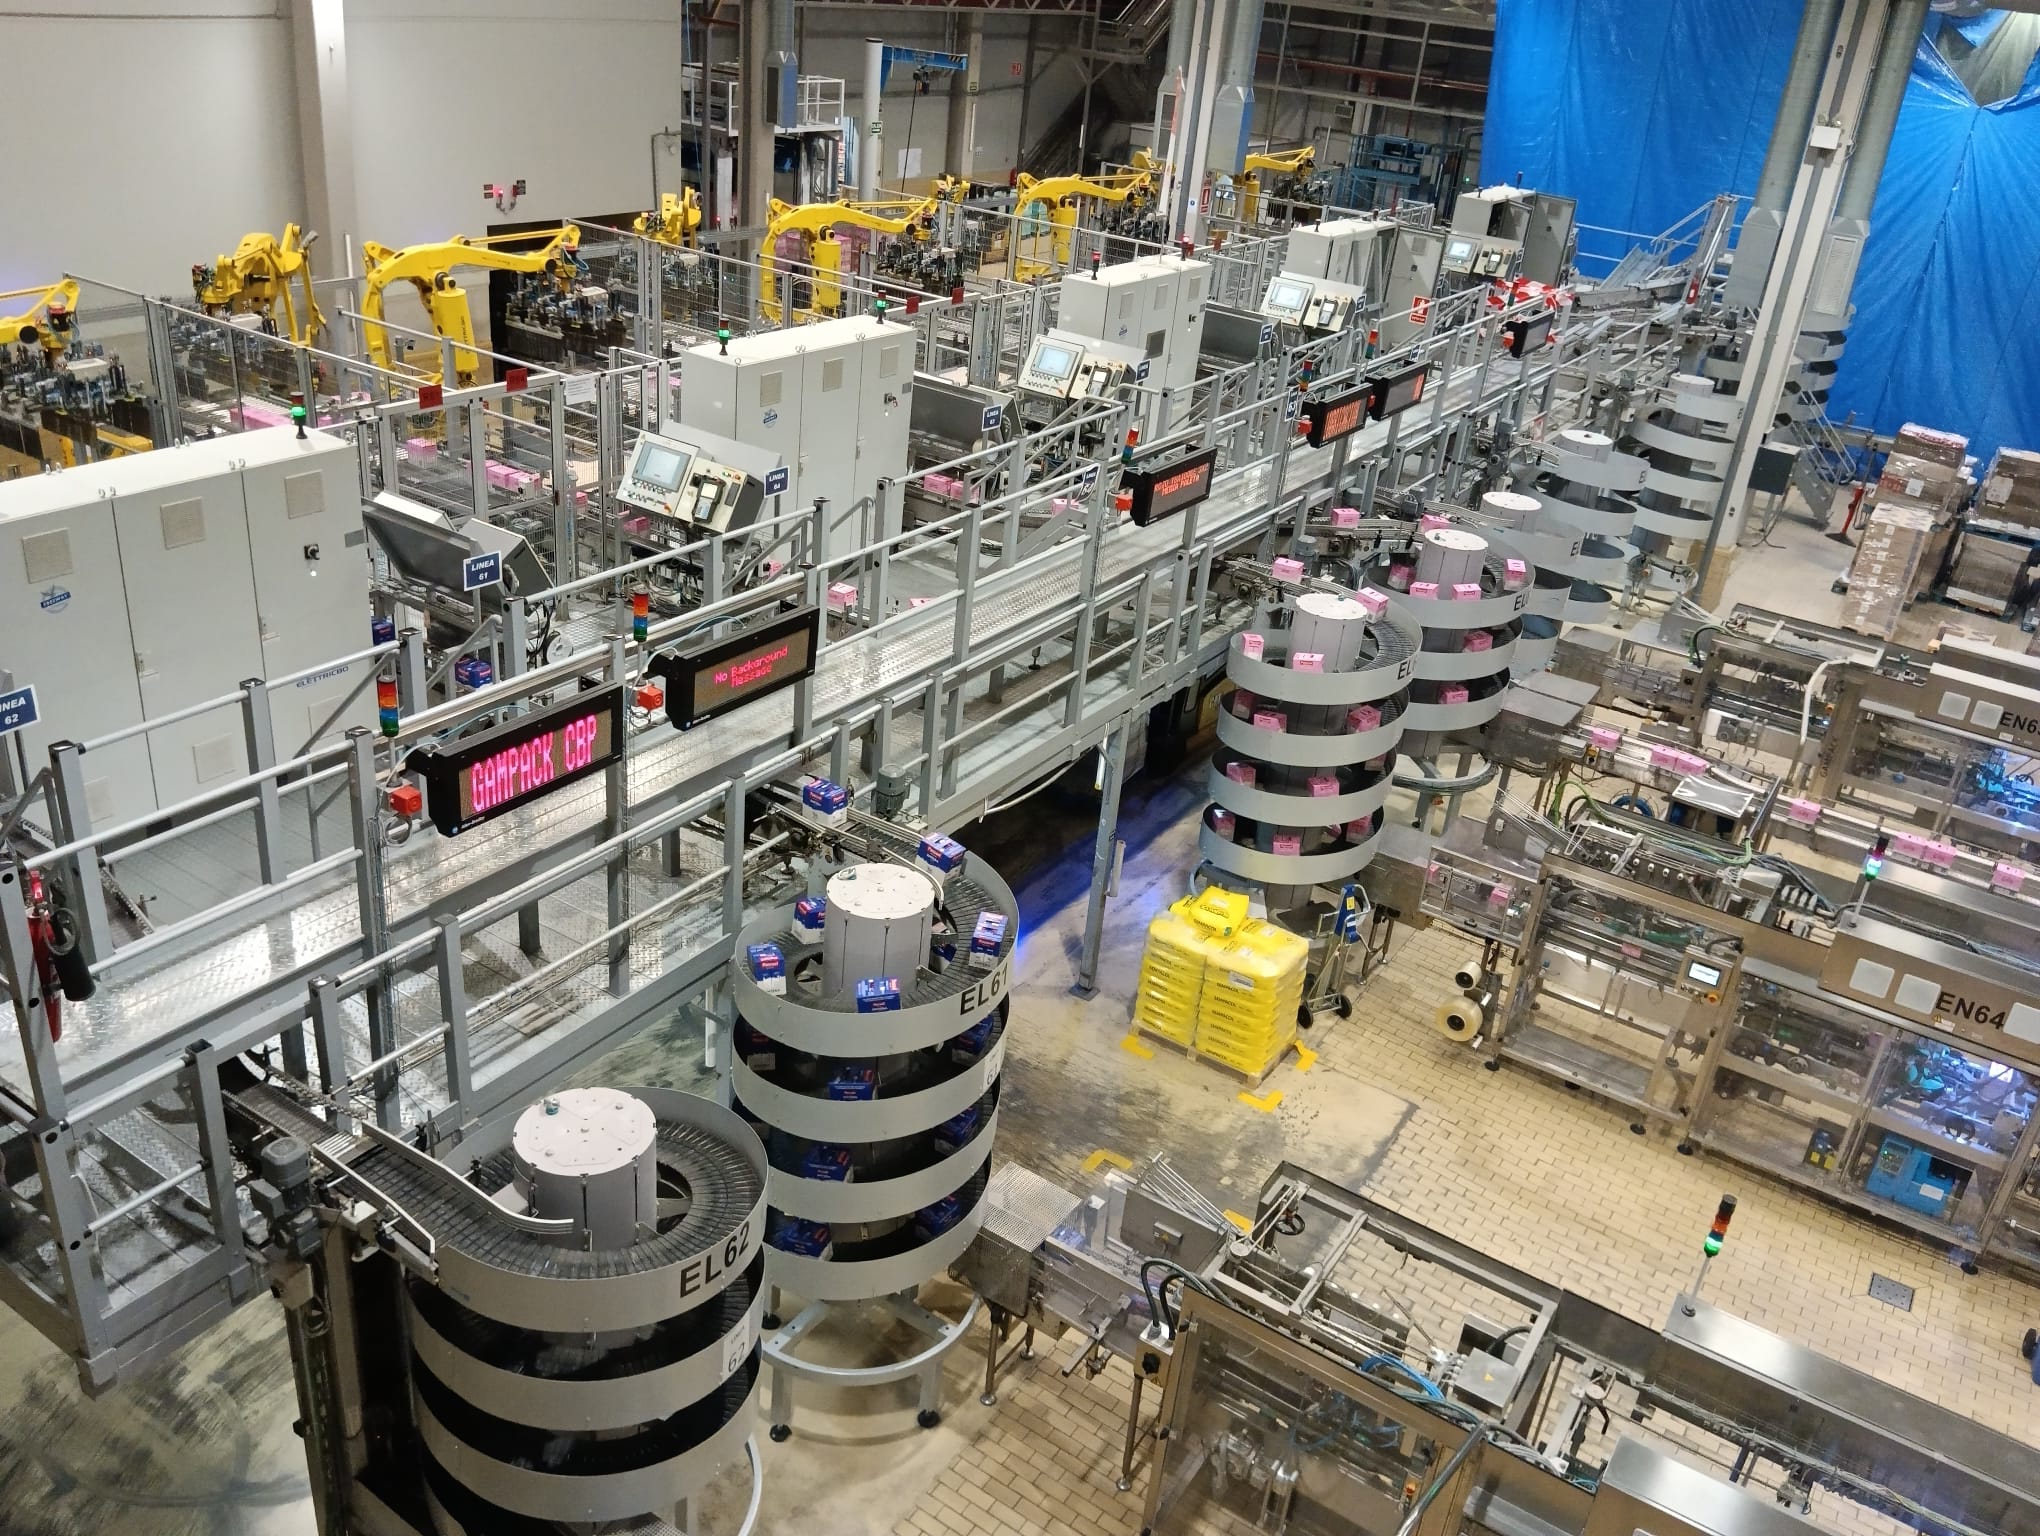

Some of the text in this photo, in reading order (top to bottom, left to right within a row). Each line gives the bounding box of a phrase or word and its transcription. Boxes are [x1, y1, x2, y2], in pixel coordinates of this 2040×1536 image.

[472, 559, 495, 571] LINEA
[714, 645, 788, 685] No Background
[732, 666, 772, 688] Message
[5, 714, 19, 725] 62
[472, 714, 597, 813] GAMPACK CBP
[960, 962, 1008, 1015] EL61
[1935, 991, 2006, 1030] EN64
[680, 1220, 750, 1298] EL62
[728, 1342, 745, 1373] 62
